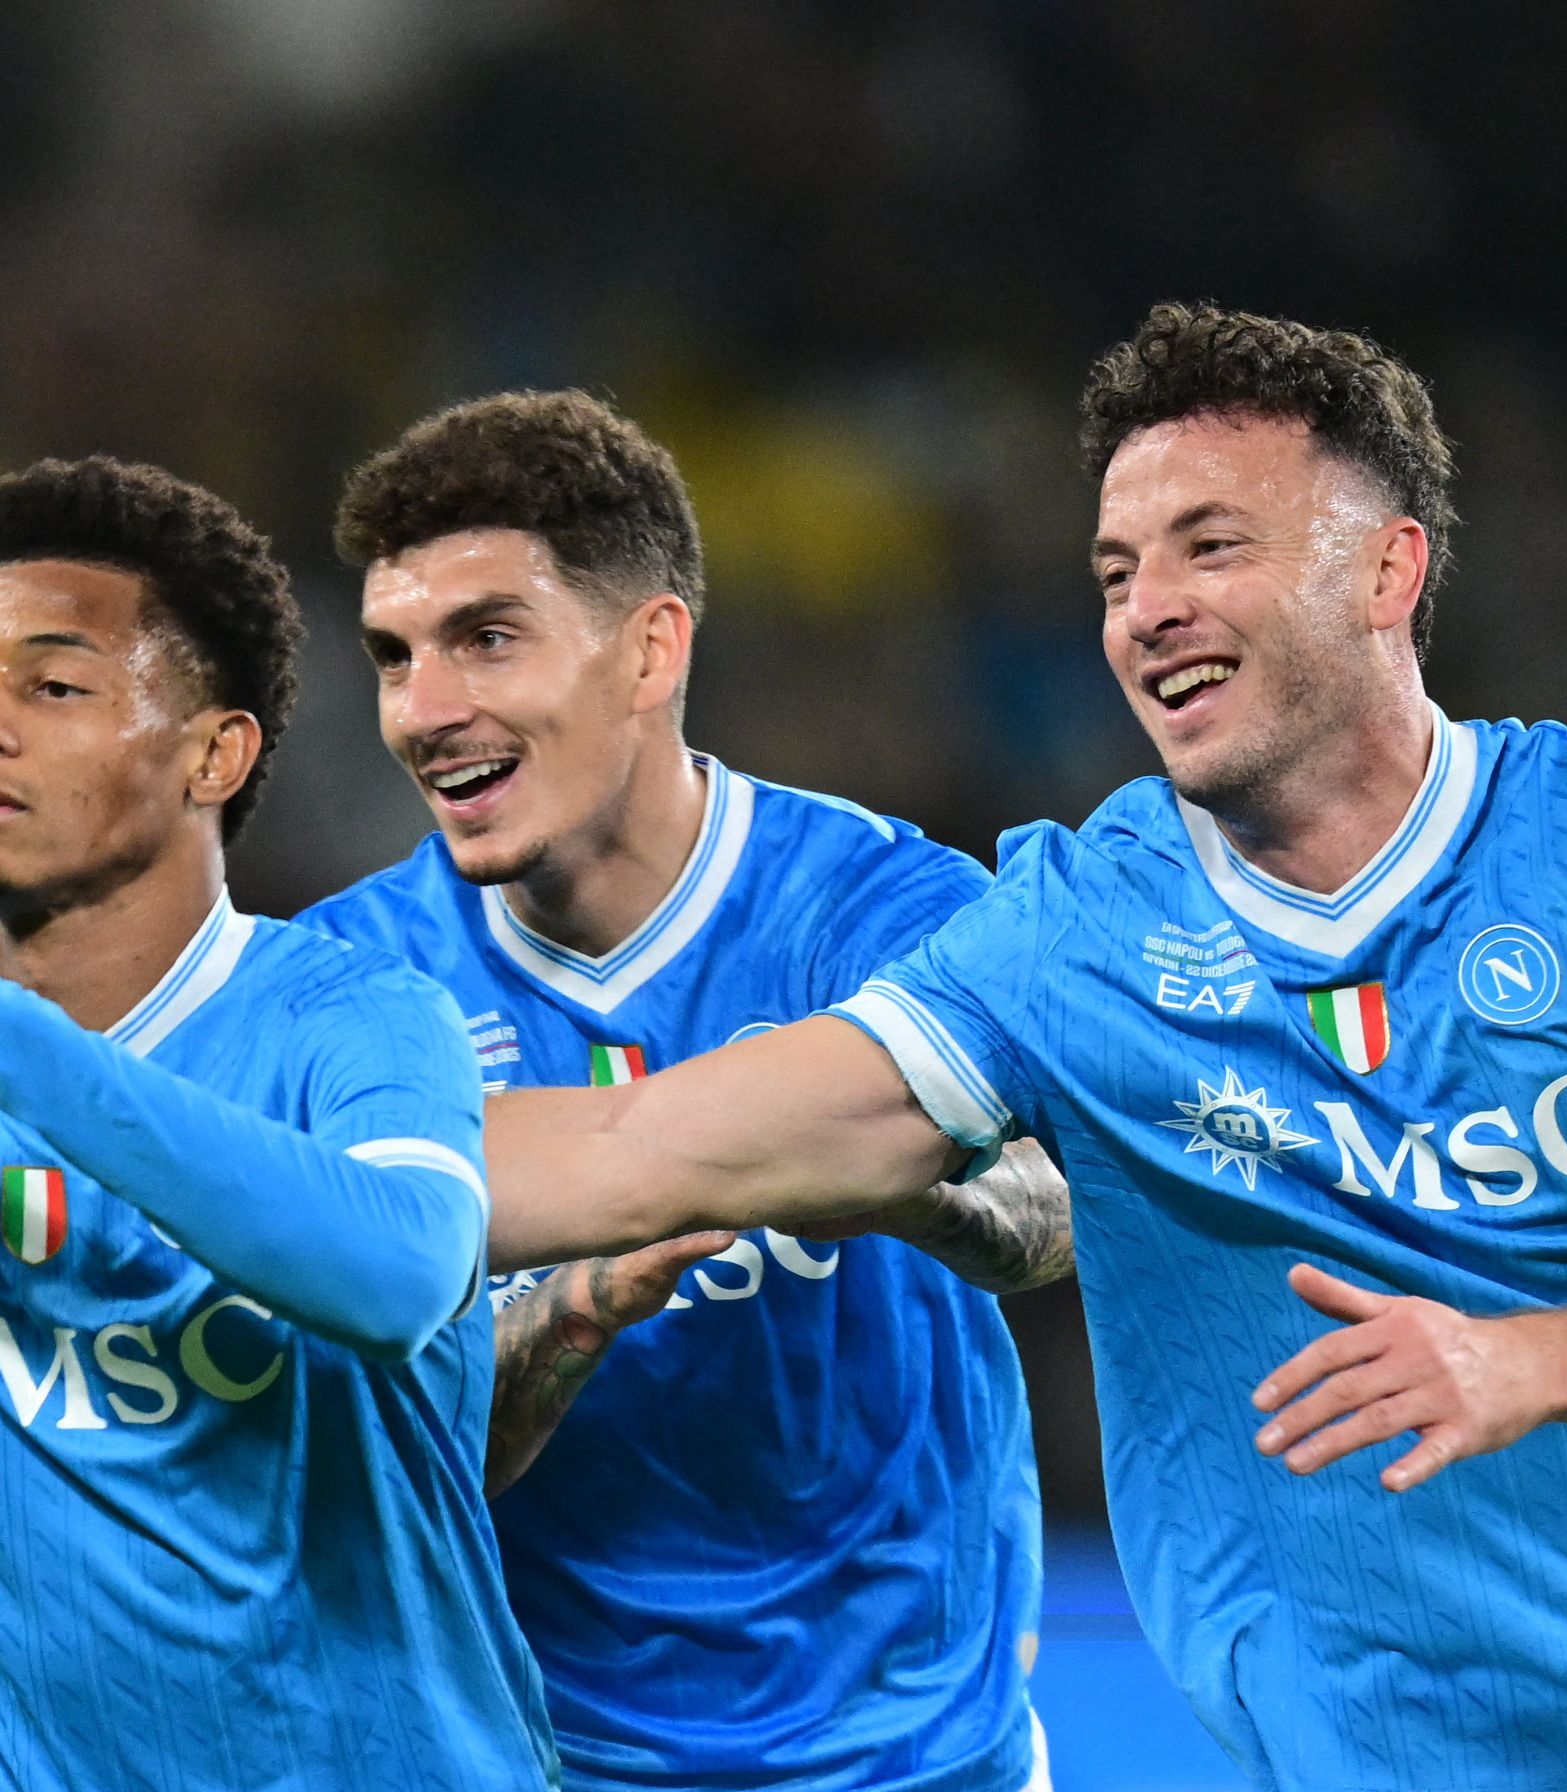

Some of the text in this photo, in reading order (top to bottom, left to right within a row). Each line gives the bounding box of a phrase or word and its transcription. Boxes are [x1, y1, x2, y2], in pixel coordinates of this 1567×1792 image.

[1165, 941, 1203, 961] NAPOLI
[1156, 972, 1256, 1015] EA7
[1483, 948, 1533, 1001] N
